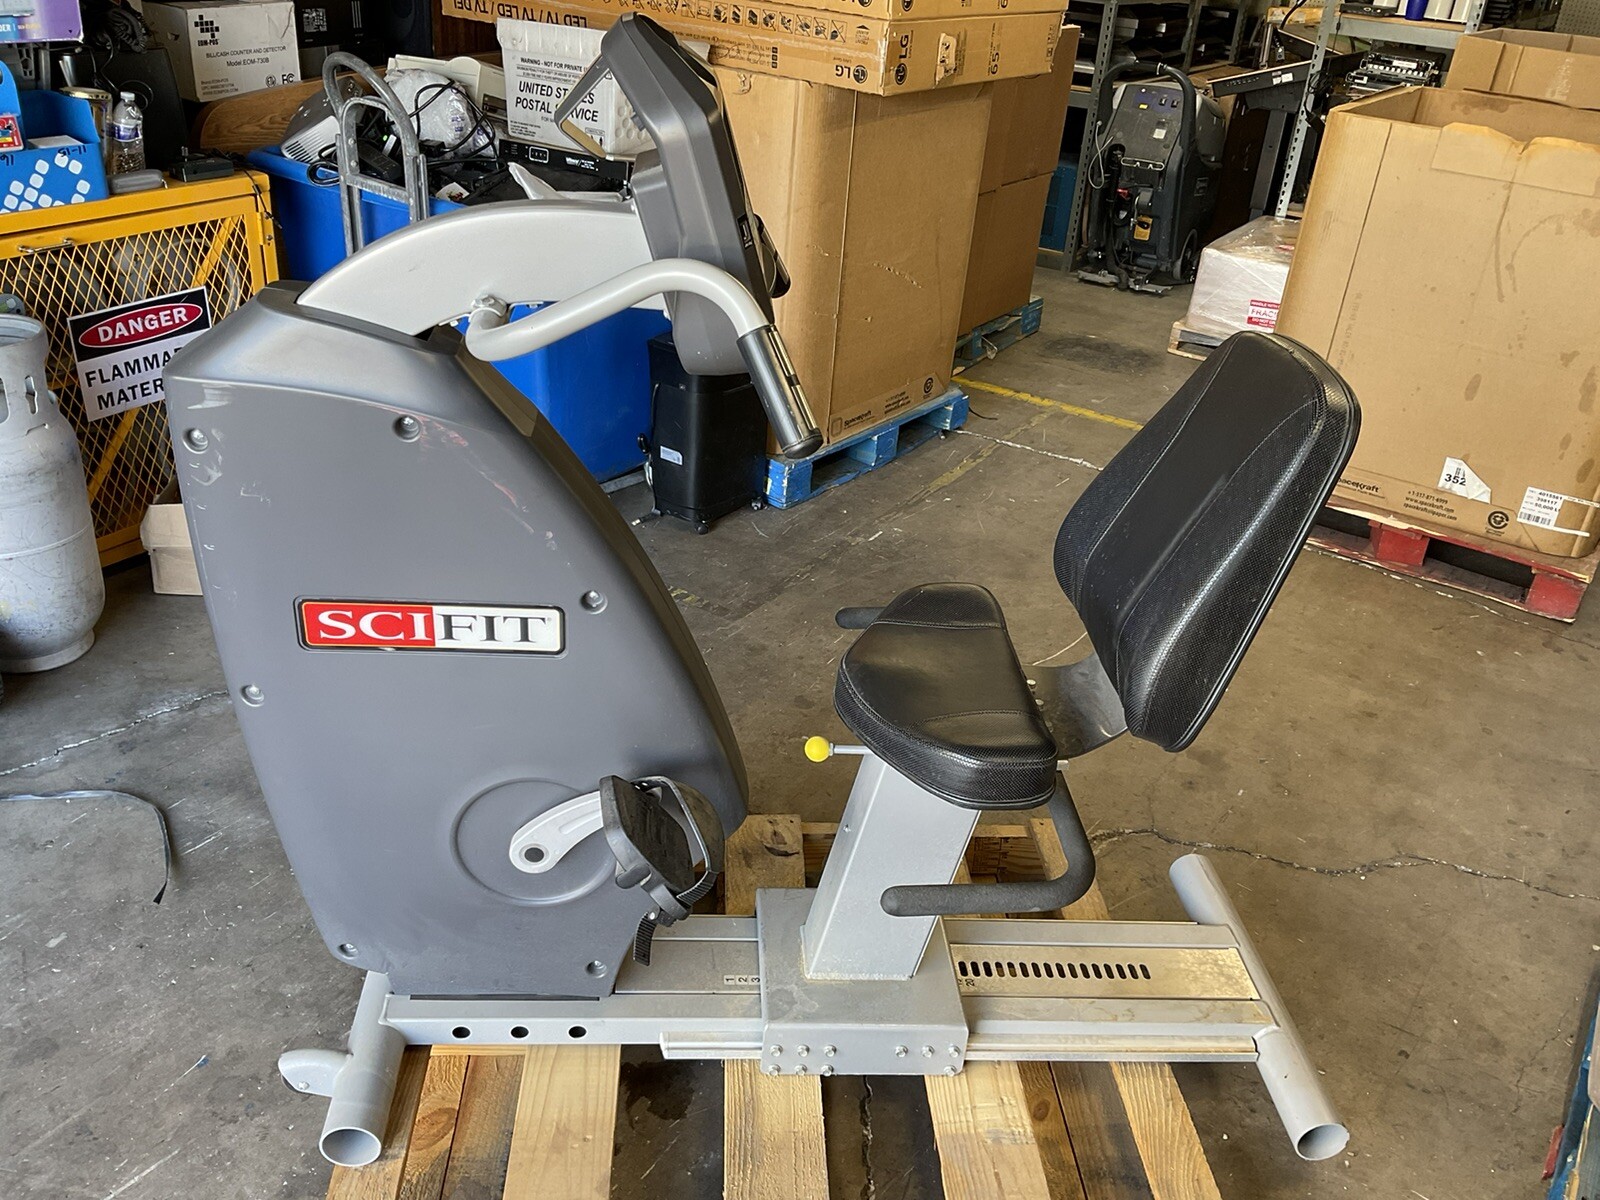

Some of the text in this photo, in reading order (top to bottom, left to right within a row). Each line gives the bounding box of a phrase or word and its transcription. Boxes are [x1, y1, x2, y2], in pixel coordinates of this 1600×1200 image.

[500, 4, 519, 18] LED
[522, 7, 537, 21] TV
[230, 49, 253, 57] COUNTER
[263, 46, 287, 54] DETECTOR
[899, 34, 909, 59] LG
[521, 57, 541, 66] WARNING
[564, 64, 582, 73] PRIVATE
[835, 65, 851, 79] LG
[519, 81, 595, 105] UNITED STS
[515, 97, 552, 114] POSTAL
[97, 307, 189, 343] DANGER
[85, 347, 183, 388] FLAMMA
[1444, 473, 1466, 486] 352
[318, 610, 547, 643] SCIFIT
